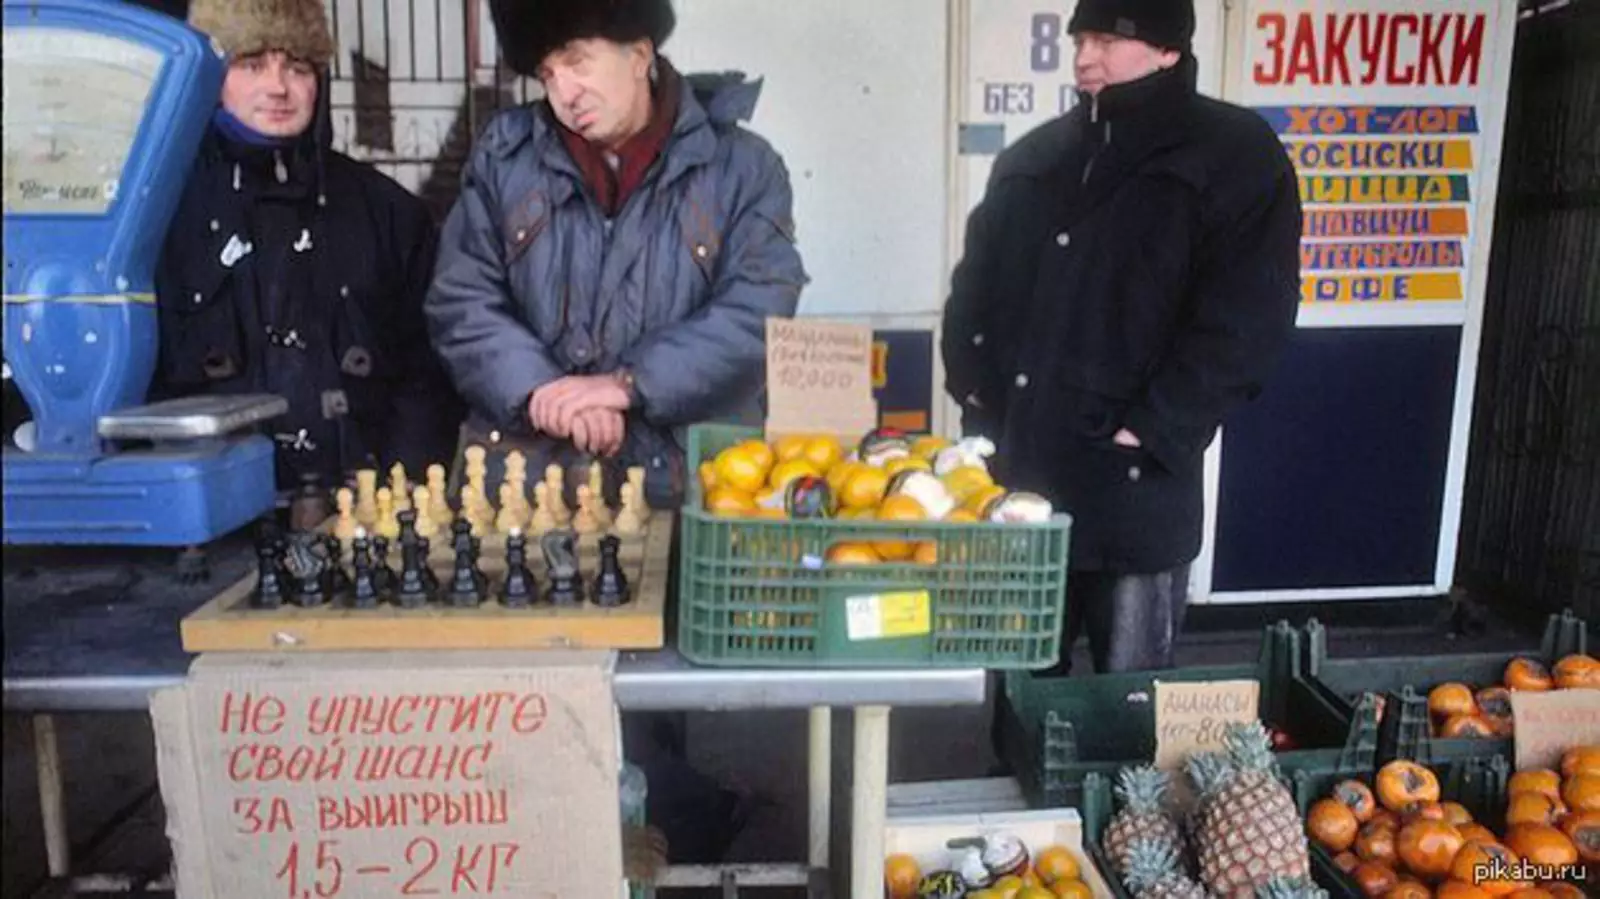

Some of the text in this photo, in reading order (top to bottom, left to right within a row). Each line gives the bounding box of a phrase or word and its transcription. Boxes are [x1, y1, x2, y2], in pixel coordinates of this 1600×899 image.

[1031, 13, 1060, 71] 8
[1254, 13, 1486, 85] ЗАКУСКИ
[984, 83, 1034, 114] БЕЗ
[1286, 106, 1472, 134] ХОТ-ДОГ
[1299, 241, 1463, 268] УТЕРБРОДЫ
[1300, 276, 1410, 300] ОФЕ
[228, 737, 494, 782] СВОЙ ШАНС
[234, 789, 508, 834] ЗА ВЫИГРЫШ
